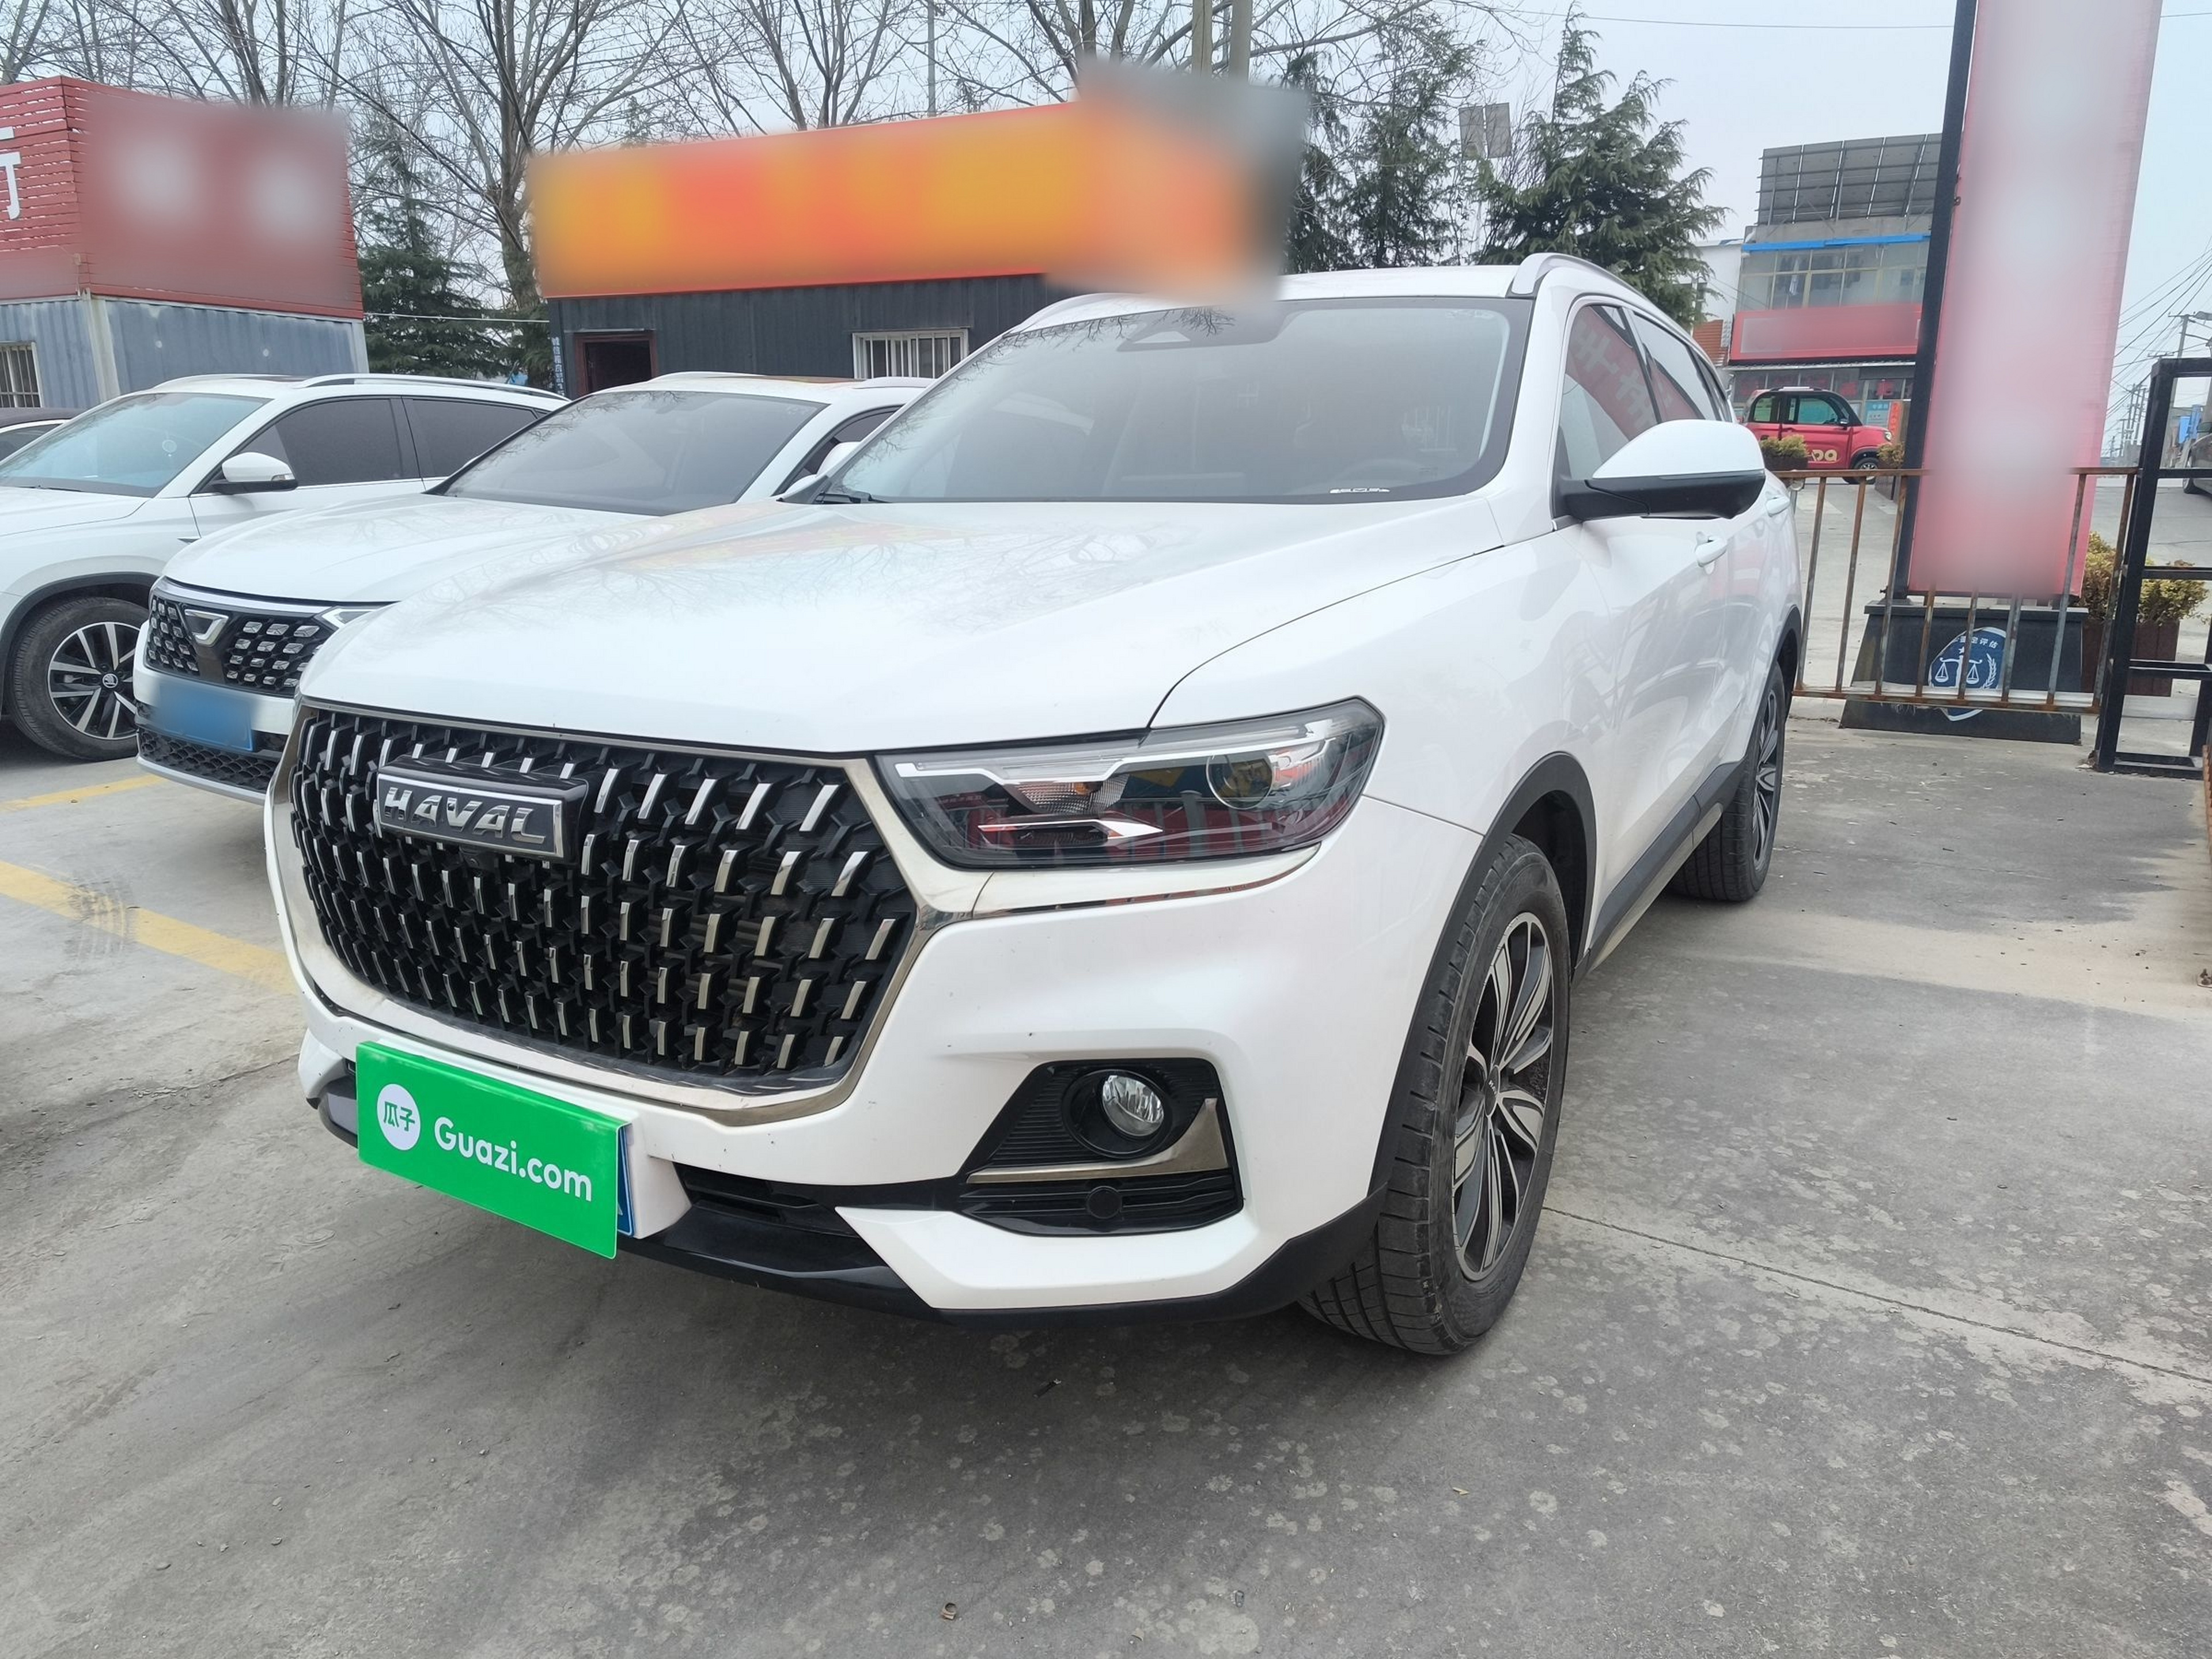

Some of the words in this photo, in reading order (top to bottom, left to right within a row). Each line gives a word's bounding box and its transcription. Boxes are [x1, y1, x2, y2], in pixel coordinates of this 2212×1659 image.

[384, 787, 546, 844] HAVAL
[384, 1101, 415, 1132] 瓜子
[434, 1116, 592, 1202] Guazi.com
